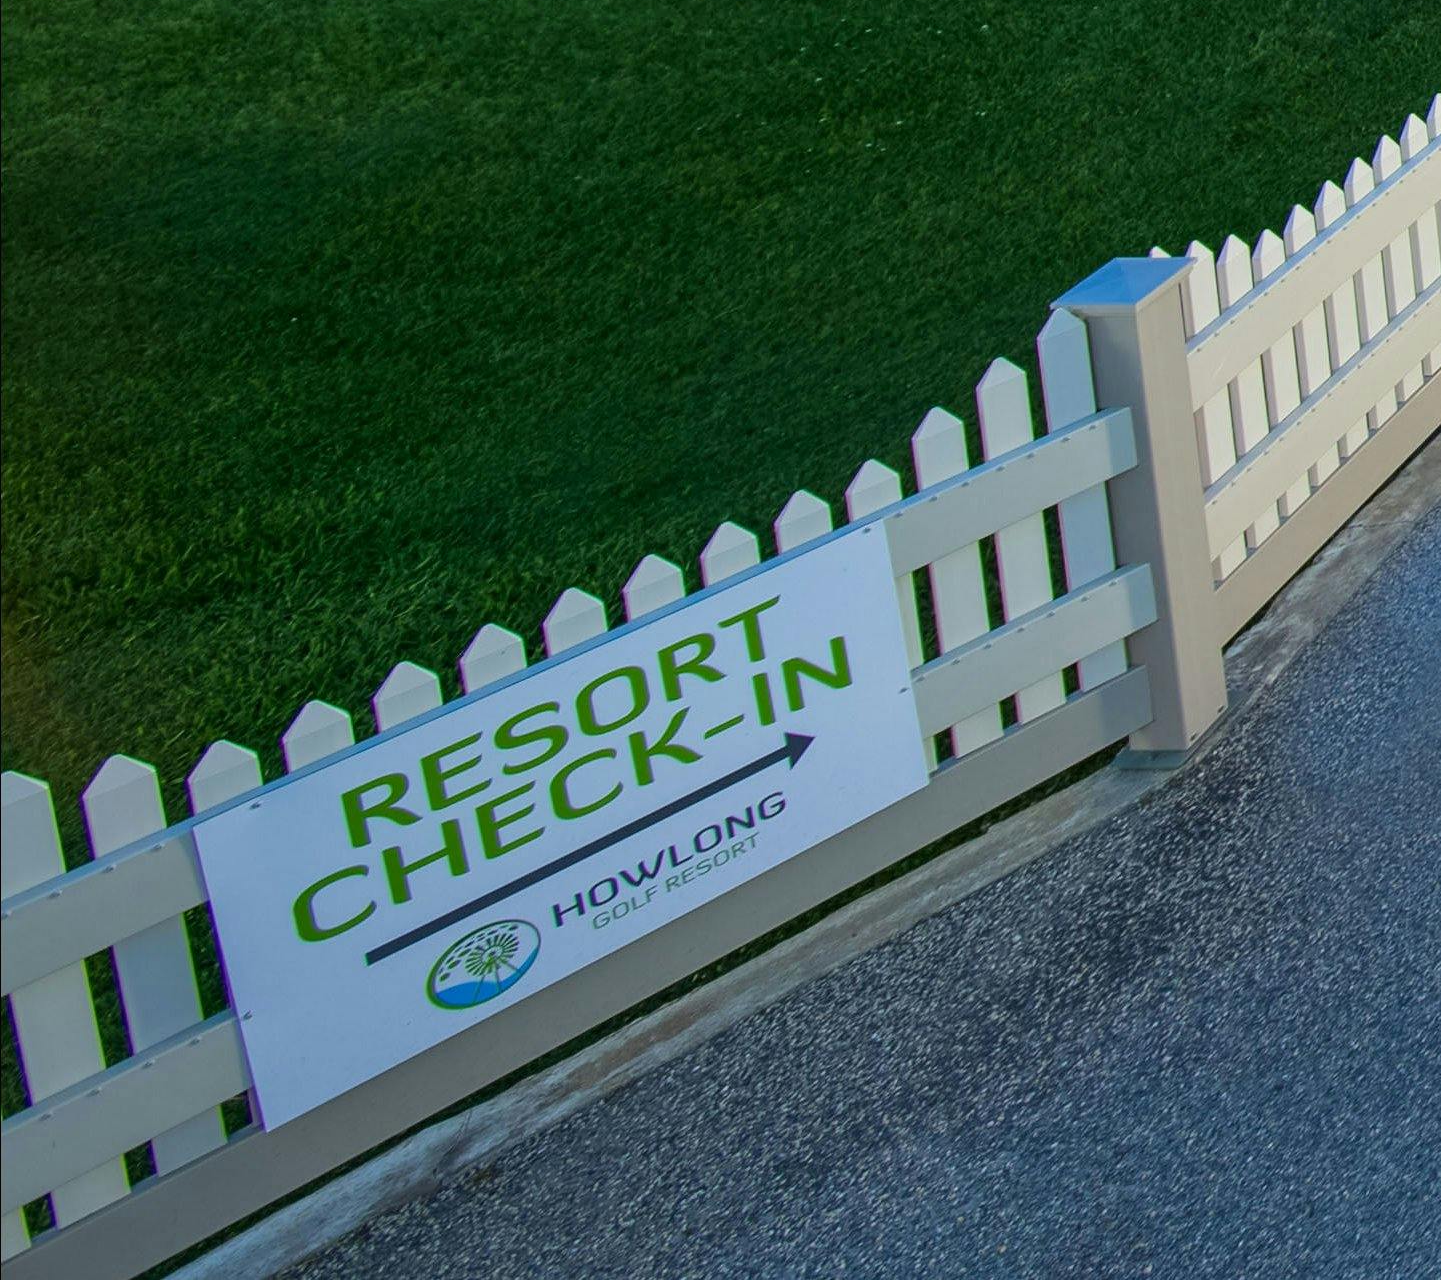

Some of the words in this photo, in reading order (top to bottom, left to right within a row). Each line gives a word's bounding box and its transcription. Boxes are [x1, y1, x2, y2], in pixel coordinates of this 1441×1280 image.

[292, 636, 853, 942] CHECK-IN
[339, 595, 781, 849] RESORT
[550, 791, 788, 929] HOWLONG
[592, 885, 658, 931] GOLF
[664, 833, 760, 893] RESORT
